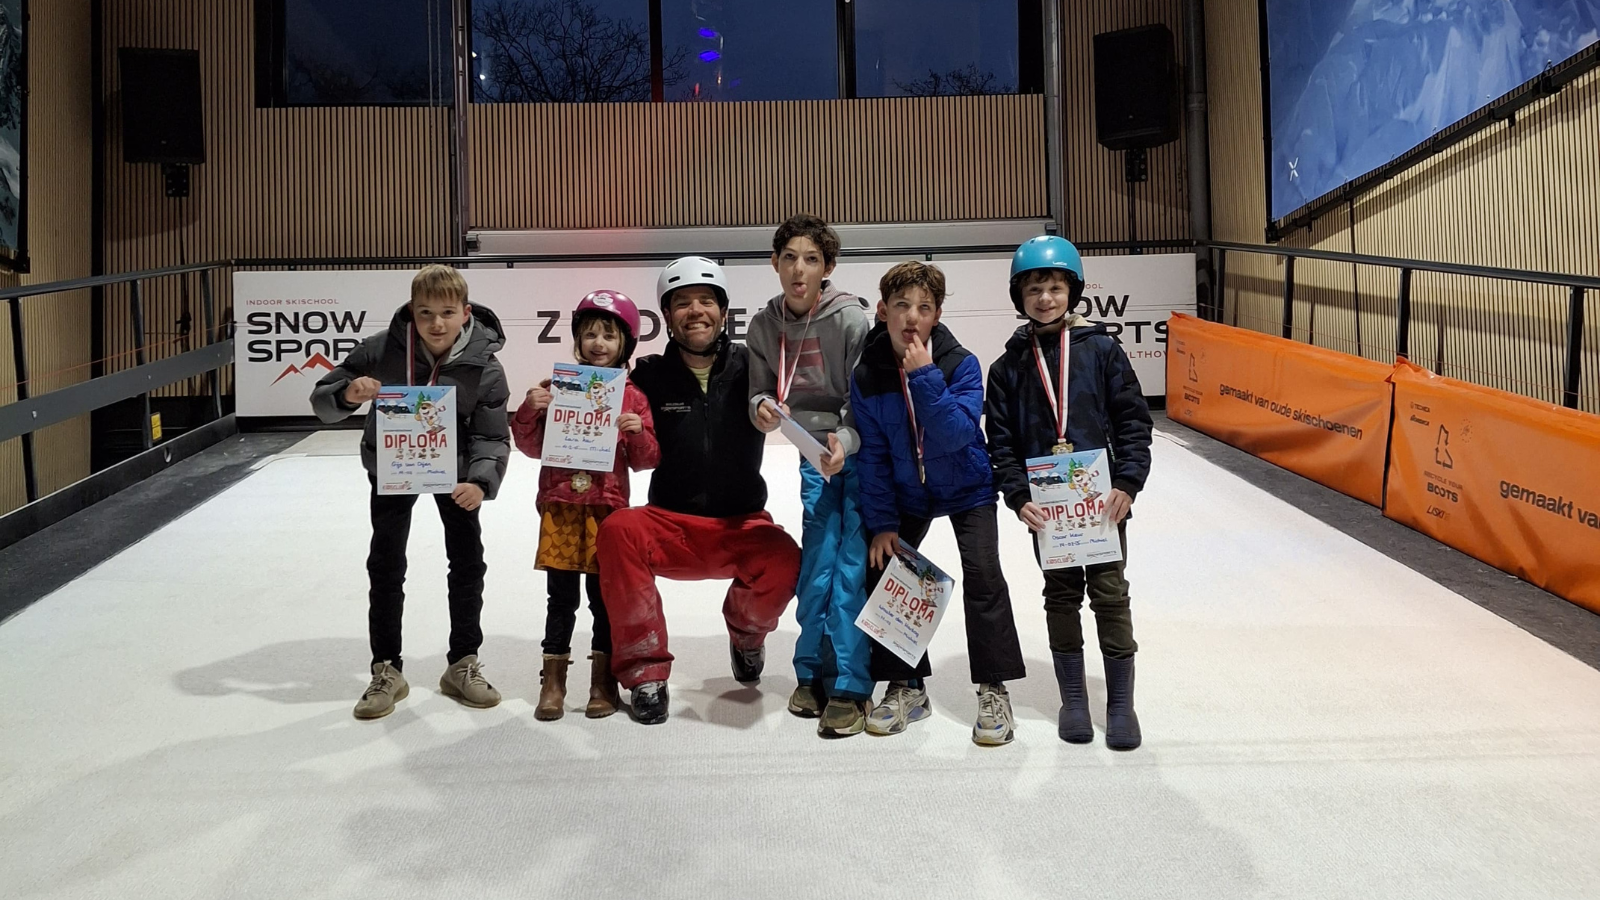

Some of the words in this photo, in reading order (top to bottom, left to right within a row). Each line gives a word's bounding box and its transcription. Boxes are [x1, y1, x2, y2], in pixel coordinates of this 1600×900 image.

[247, 311, 367, 335] SNOW
[553, 408, 611, 427] DIPLOMA
[1219, 383, 1254, 404] gemaakt
[1254, 395, 1269, 410] van
[1270, 401, 1292, 418] oude
[1292, 408, 1363, 440] skischoenen
[384, 433, 448, 449] DIPLOMA
[1427, 481, 1459, 503] BOOTS
[1040, 499, 1105, 521] DIPLOMA
[1500, 480, 1574, 519] gemaakt
[1577, 508, 1600, 529] va
[884, 578, 935, 623] DIPLOMA
